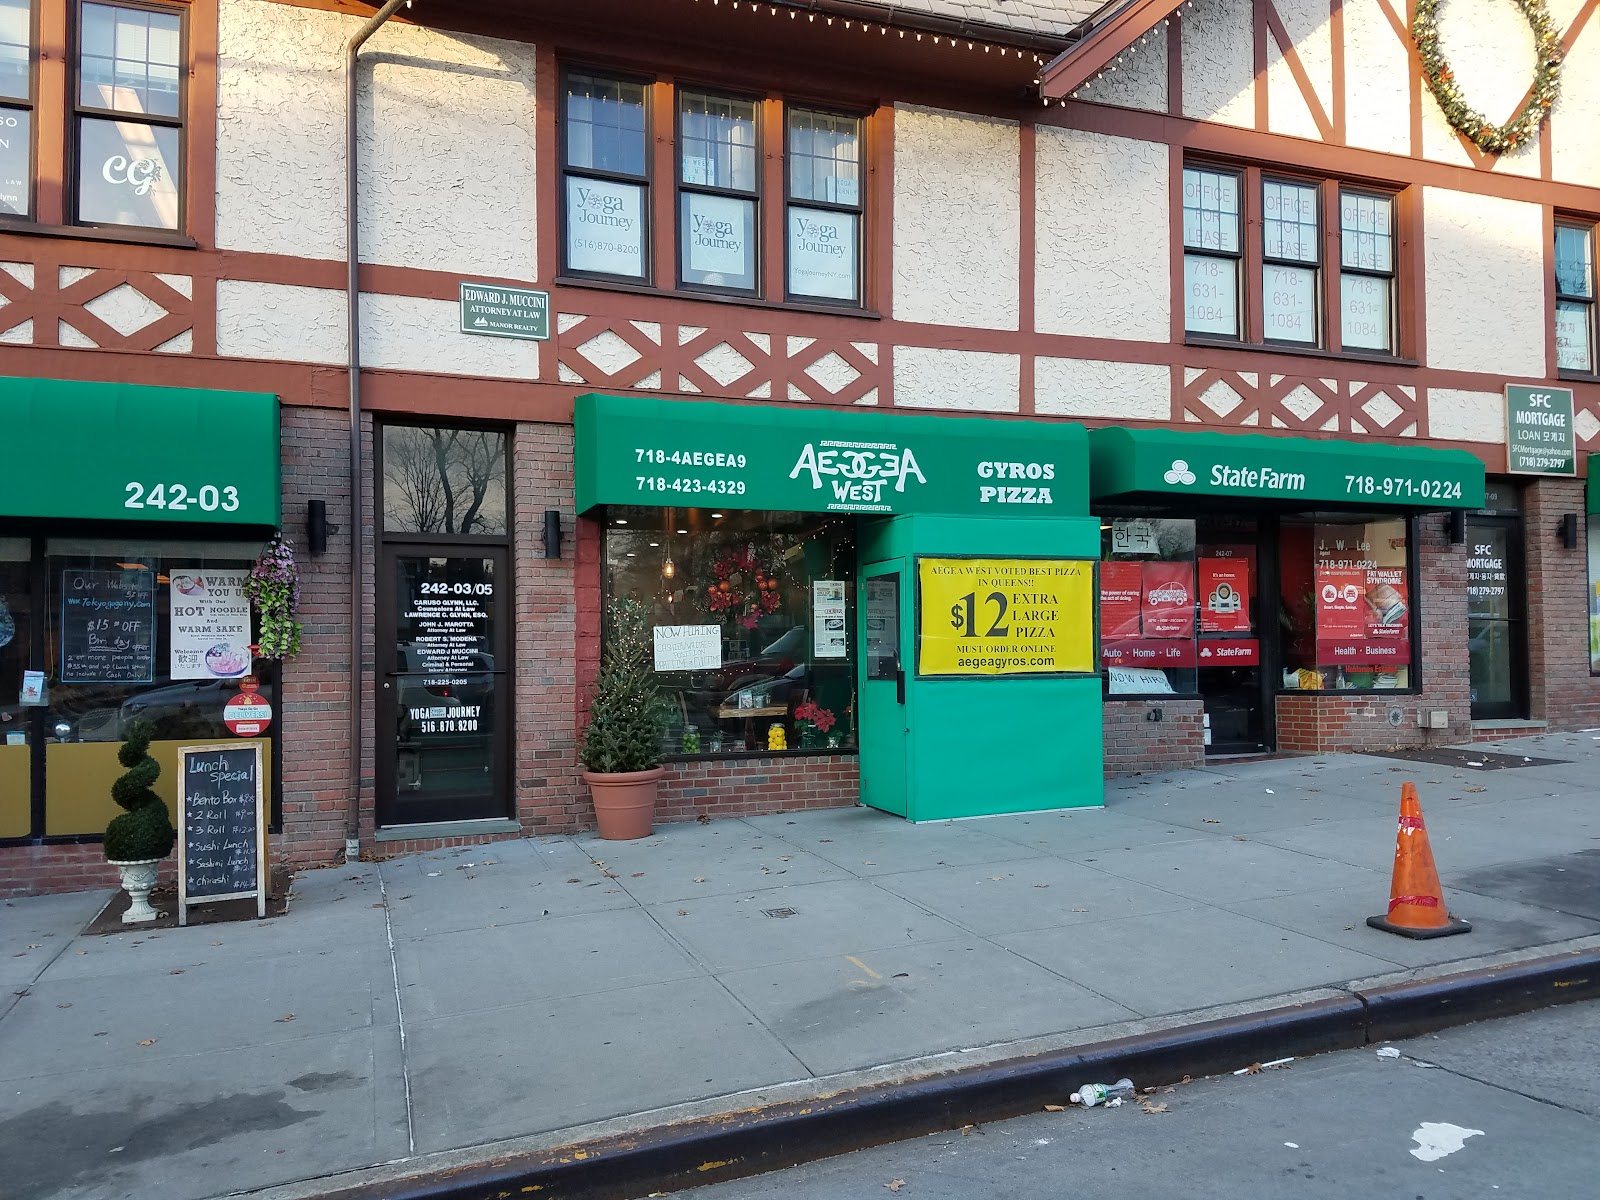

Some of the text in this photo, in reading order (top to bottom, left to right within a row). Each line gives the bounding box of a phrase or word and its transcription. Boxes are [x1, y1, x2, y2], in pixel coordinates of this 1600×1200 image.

[1185, 183, 1230, 202] OFFICE
[1266, 195, 1310, 215] OFFICE
[579, 209, 634, 231] Journey
[1195, 208, 1220, 223] FOR
[1343, 207, 1384, 226] OFFICE
[1276, 221, 1300, 234] FOR
[695, 234, 742, 252] Journey
[1188, 228, 1228, 246] LEASE
[1352, 232, 1374, 245] FOR
[574, 239, 638, 254] (516)870-8200
[799, 238, 846, 258] Journey
[1269, 240, 1308, 257] LEASE
[1346, 251, 1383, 268] LEASE
[1192, 260, 1224, 277] 718-
[1273, 270, 1302, 286] 718-
[1192, 282, 1224, 299] 631-
[1350, 278, 1378, 294] 718-
[465, 289, 545, 308] EDWARD J. MUCCINI
[1273, 292, 1302, 308] 631-
[470, 305, 512, 316] ATTORNEY
[524, 311, 540, 319] LAW
[1189, 305, 1223, 322] 1084
[1350, 300, 1378, 315] 631-
[1270, 314, 1302, 330] 1084
[1347, 321, 1377, 336] 1084
[1529, 394, 1552, 408] SFC
[1516, 410, 1566, 427] MORTGAGE
[1518, 430, 1540, 440] LOAN
[635, 448, 746, 468] 718-4AEGEA9
[1520, 456, 1565, 468] (718) 279-2797
[978, 462, 1054, 480] GYROS
[636, 476, 746, 494] 718-423-4329
[832, 479, 888, 502] WEST
[1345, 475, 1462, 500] 718-971-0224
[124, 482, 240, 511] 242-03
[980, 486, 1052, 504] PIZZA
[1114, 526, 1151, 548] 한국
[1319, 540, 1370, 551] J. W. Lee
[1474, 544, 1492, 555] SFC
[931, 566, 963, 574] AEGEA
[966, 567, 992, 575] WEST
[994, 567, 1026, 575] VOTED
[1055, 568, 1080, 576] PIZZA
[1318, 560, 1378, 570] 718-971-0224
[74, 578, 99, 590] Our
[421, 583, 492, 596] 242-03/05
[978, 579, 1034, 588] IN QUEENS!!
[1479, 587, 1504, 595] 279-2797
[208, 588, 230, 597] YOU
[1012, 594, 1058, 604] EXTRA
[174, 606, 205, 616] HOT
[951, 592, 1010, 638] $12
[1012, 610, 1059, 620] LARGE
[122, 621, 141, 632] OFF
[656, 626, 719, 639] NOW HIRING
[1016, 627, 1055, 638] PIZZA
[1020, 645, 1056, 653] ONLINE
[1103, 648, 1180, 657] Auto Home Life
[1334, 646, 1396, 655] Health Business
[112, 655, 134, 663] people
[958, 657, 1054, 669] aegeagyros.com
[1110, 672, 1134, 683] NOW
[410, 708, 430, 720] YOGA
[447, 706, 480, 718] JOURNEY
[422, 720, 478, 733] 516.870.8200
[190, 755, 228, 773] Lunch
[210, 765, 254, 789] special
[192, 790, 237, 806] Bento Box
[194, 810, 226, 820] 2 Roll
[196, 825, 225, 834] 3 Roll
[195, 839, 248, 851] Sushi Lunch
[228, 856, 248, 866] Lunch
